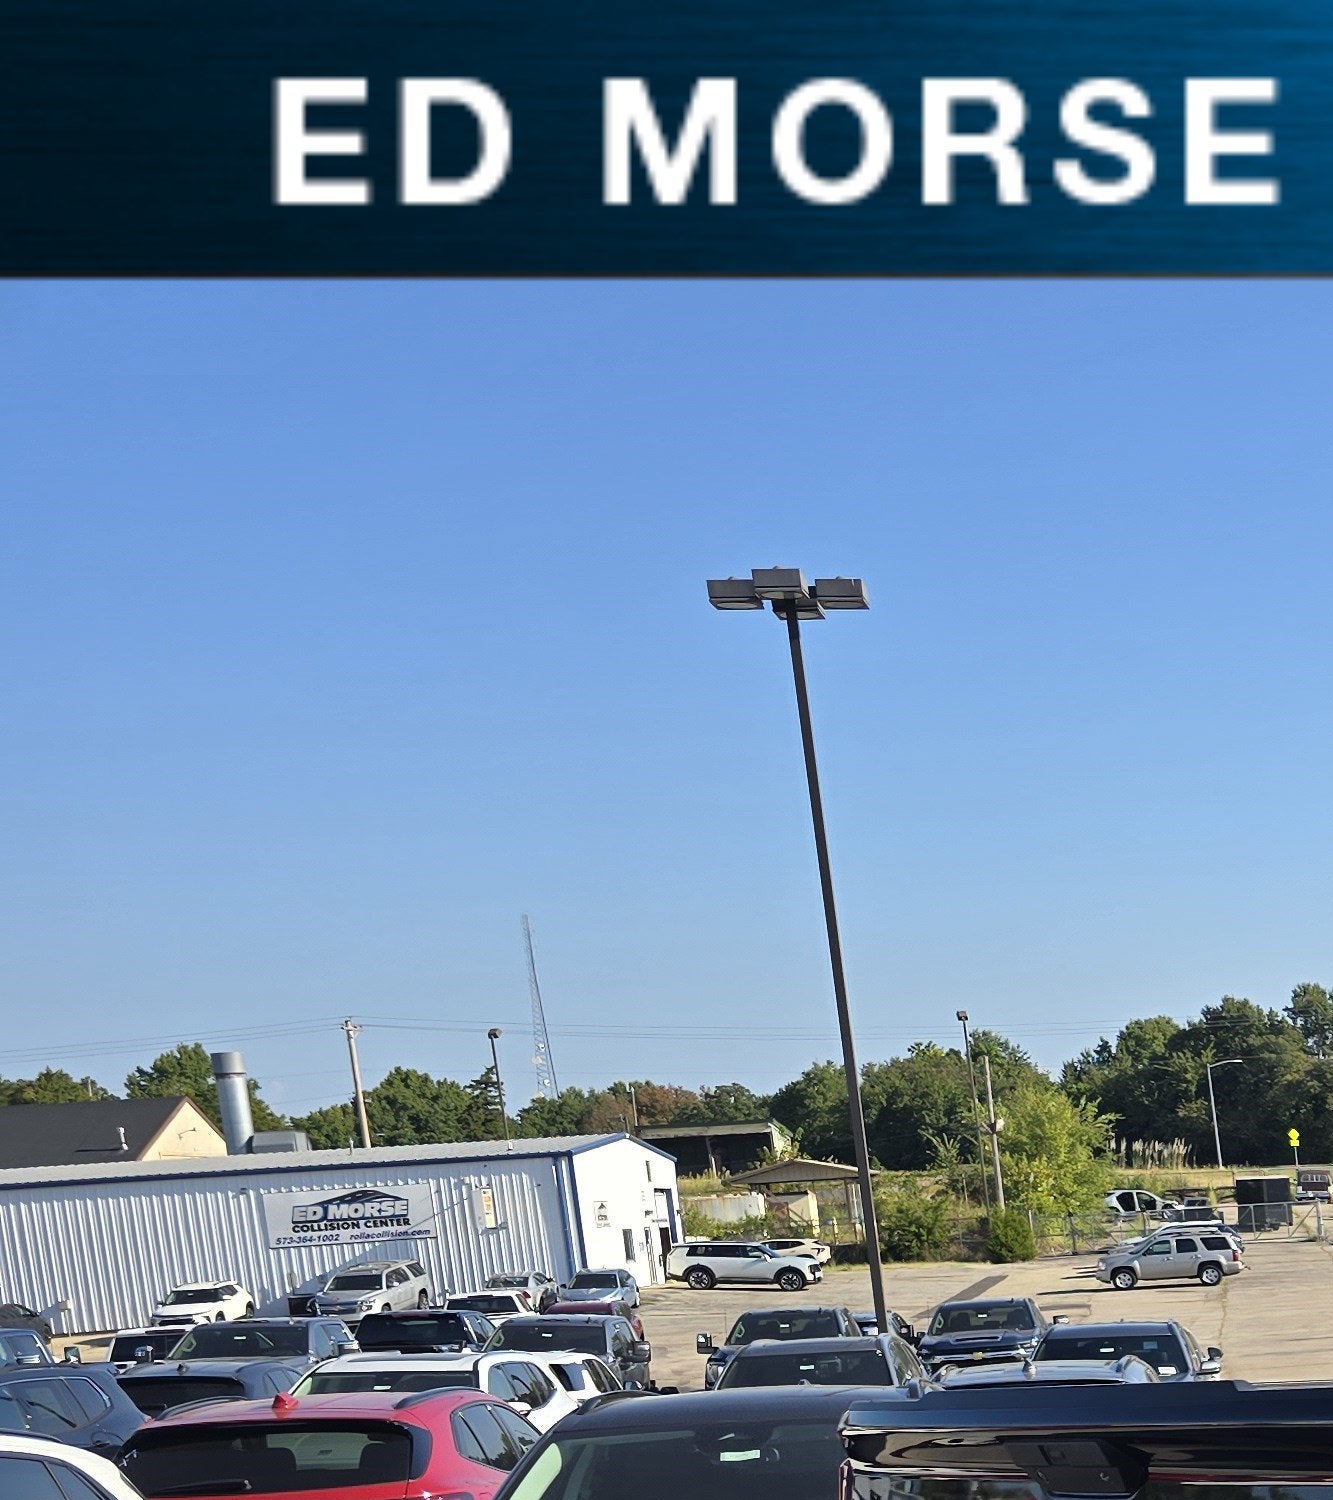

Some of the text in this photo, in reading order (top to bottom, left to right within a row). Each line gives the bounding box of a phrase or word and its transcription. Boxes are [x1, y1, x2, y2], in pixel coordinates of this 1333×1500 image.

[292, 1200, 409, 1222] ED MORSE
[291, 1217, 411, 1234] COLLISION CENTER
[275, 1229, 431, 1246] 573-364-1002 rollacollision.com
